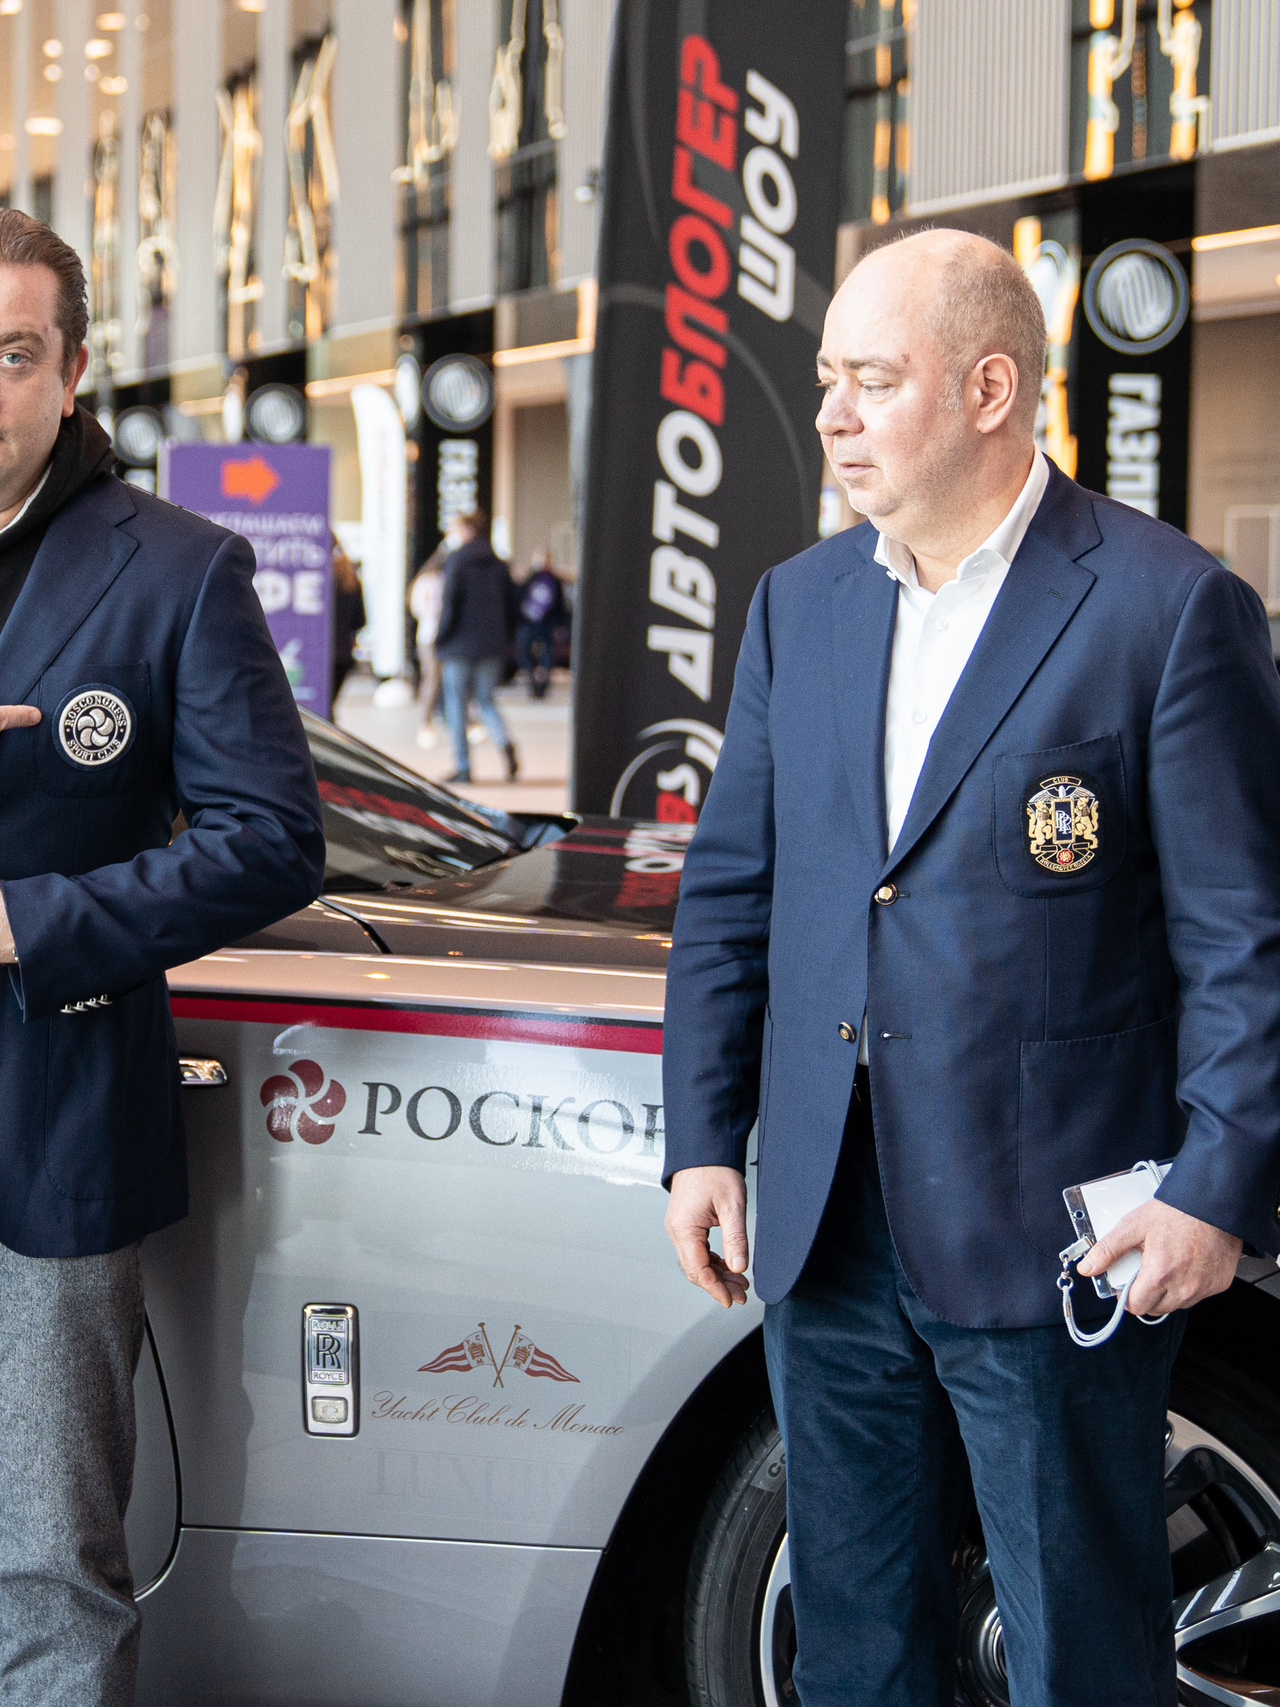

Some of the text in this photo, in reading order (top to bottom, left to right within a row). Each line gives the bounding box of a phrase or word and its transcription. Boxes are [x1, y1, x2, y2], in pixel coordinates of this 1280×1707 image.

[737, 68, 800, 323] ШОУ
[646, 33, 739, 703] АВТОБЛОГЕР
[252, 569, 324, 615] ФЕ
[64, 694, 127, 728] ROSCONGRESS
[66, 739, 121, 762] SPORT CLUB
[313, 1320, 344, 1331] ROLLS
[313, 1371, 344, 1381] ROYCE
[371, 1390, 625, 1436] Yacht Club de Monaco
